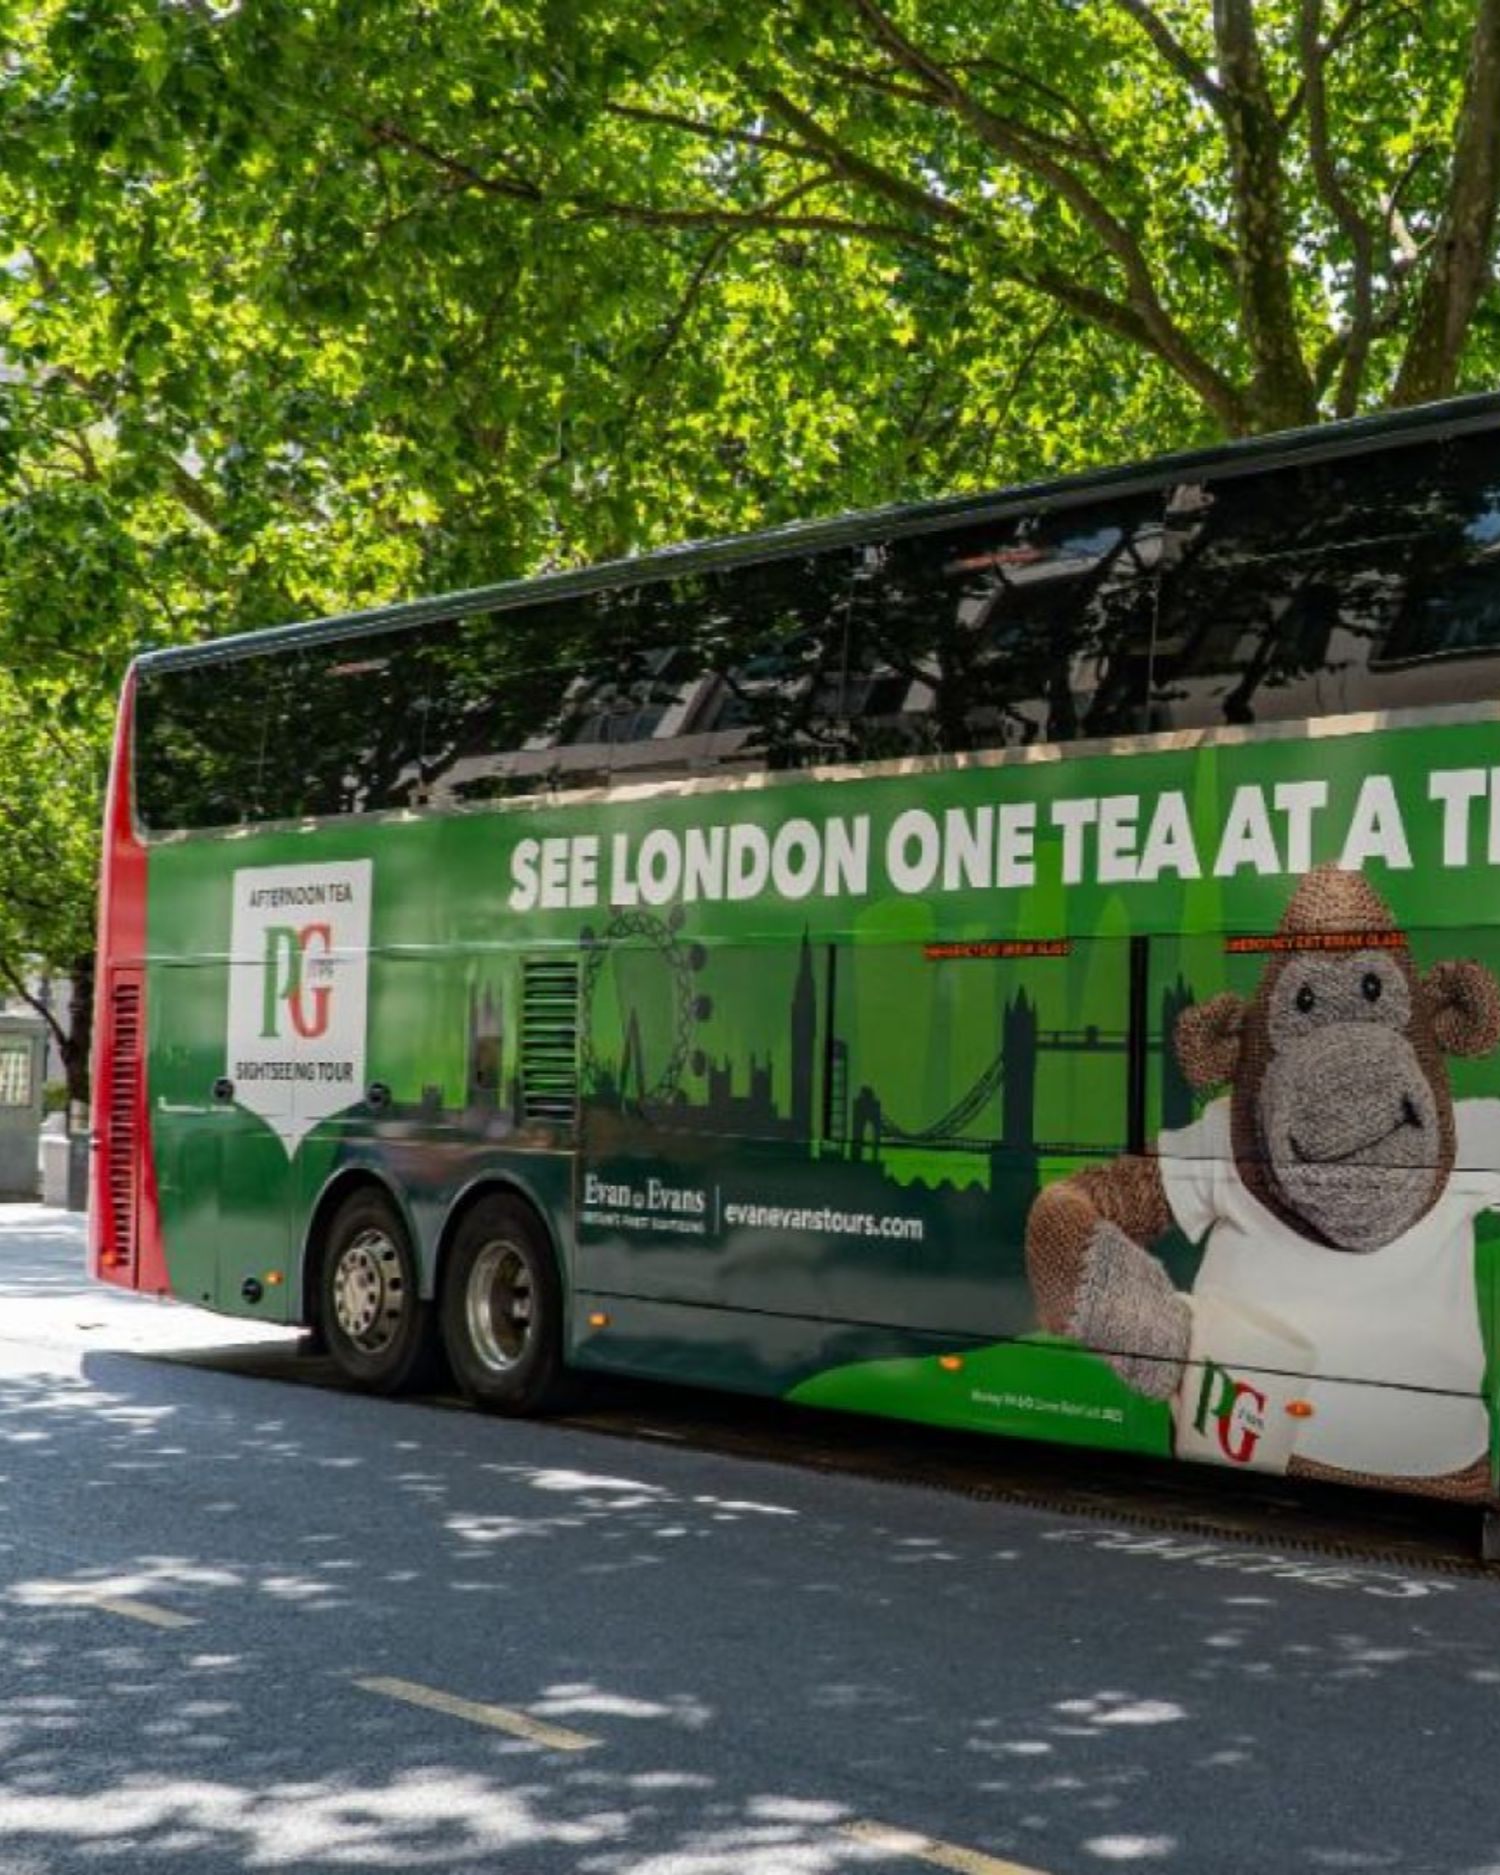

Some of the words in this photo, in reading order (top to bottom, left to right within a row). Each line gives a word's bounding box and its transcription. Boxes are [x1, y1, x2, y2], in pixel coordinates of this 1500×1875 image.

[508, 835, 599, 912] SEE
[611, 815, 870, 907] LONDON
[885, 803, 1035, 895] ONE
[1051, 791, 1202, 885] TEA
[1213, 780, 1328, 876] AT
[1338, 775, 1413, 870] A
[249, 886, 325, 907] AFTERNOON
[328, 883, 353, 904] TEA
[259, 922, 332, 1038] PG
[236, 1062, 316, 1081] SIGHTSEEING
[317, 1062, 353, 1082] TOUR
[584, 1174, 630, 1206] Evan
[646, 1178, 705, 1212] Evans
[724, 1203, 923, 1239] evanevanstours.com
[1192, 1355, 1266, 1463] PG
